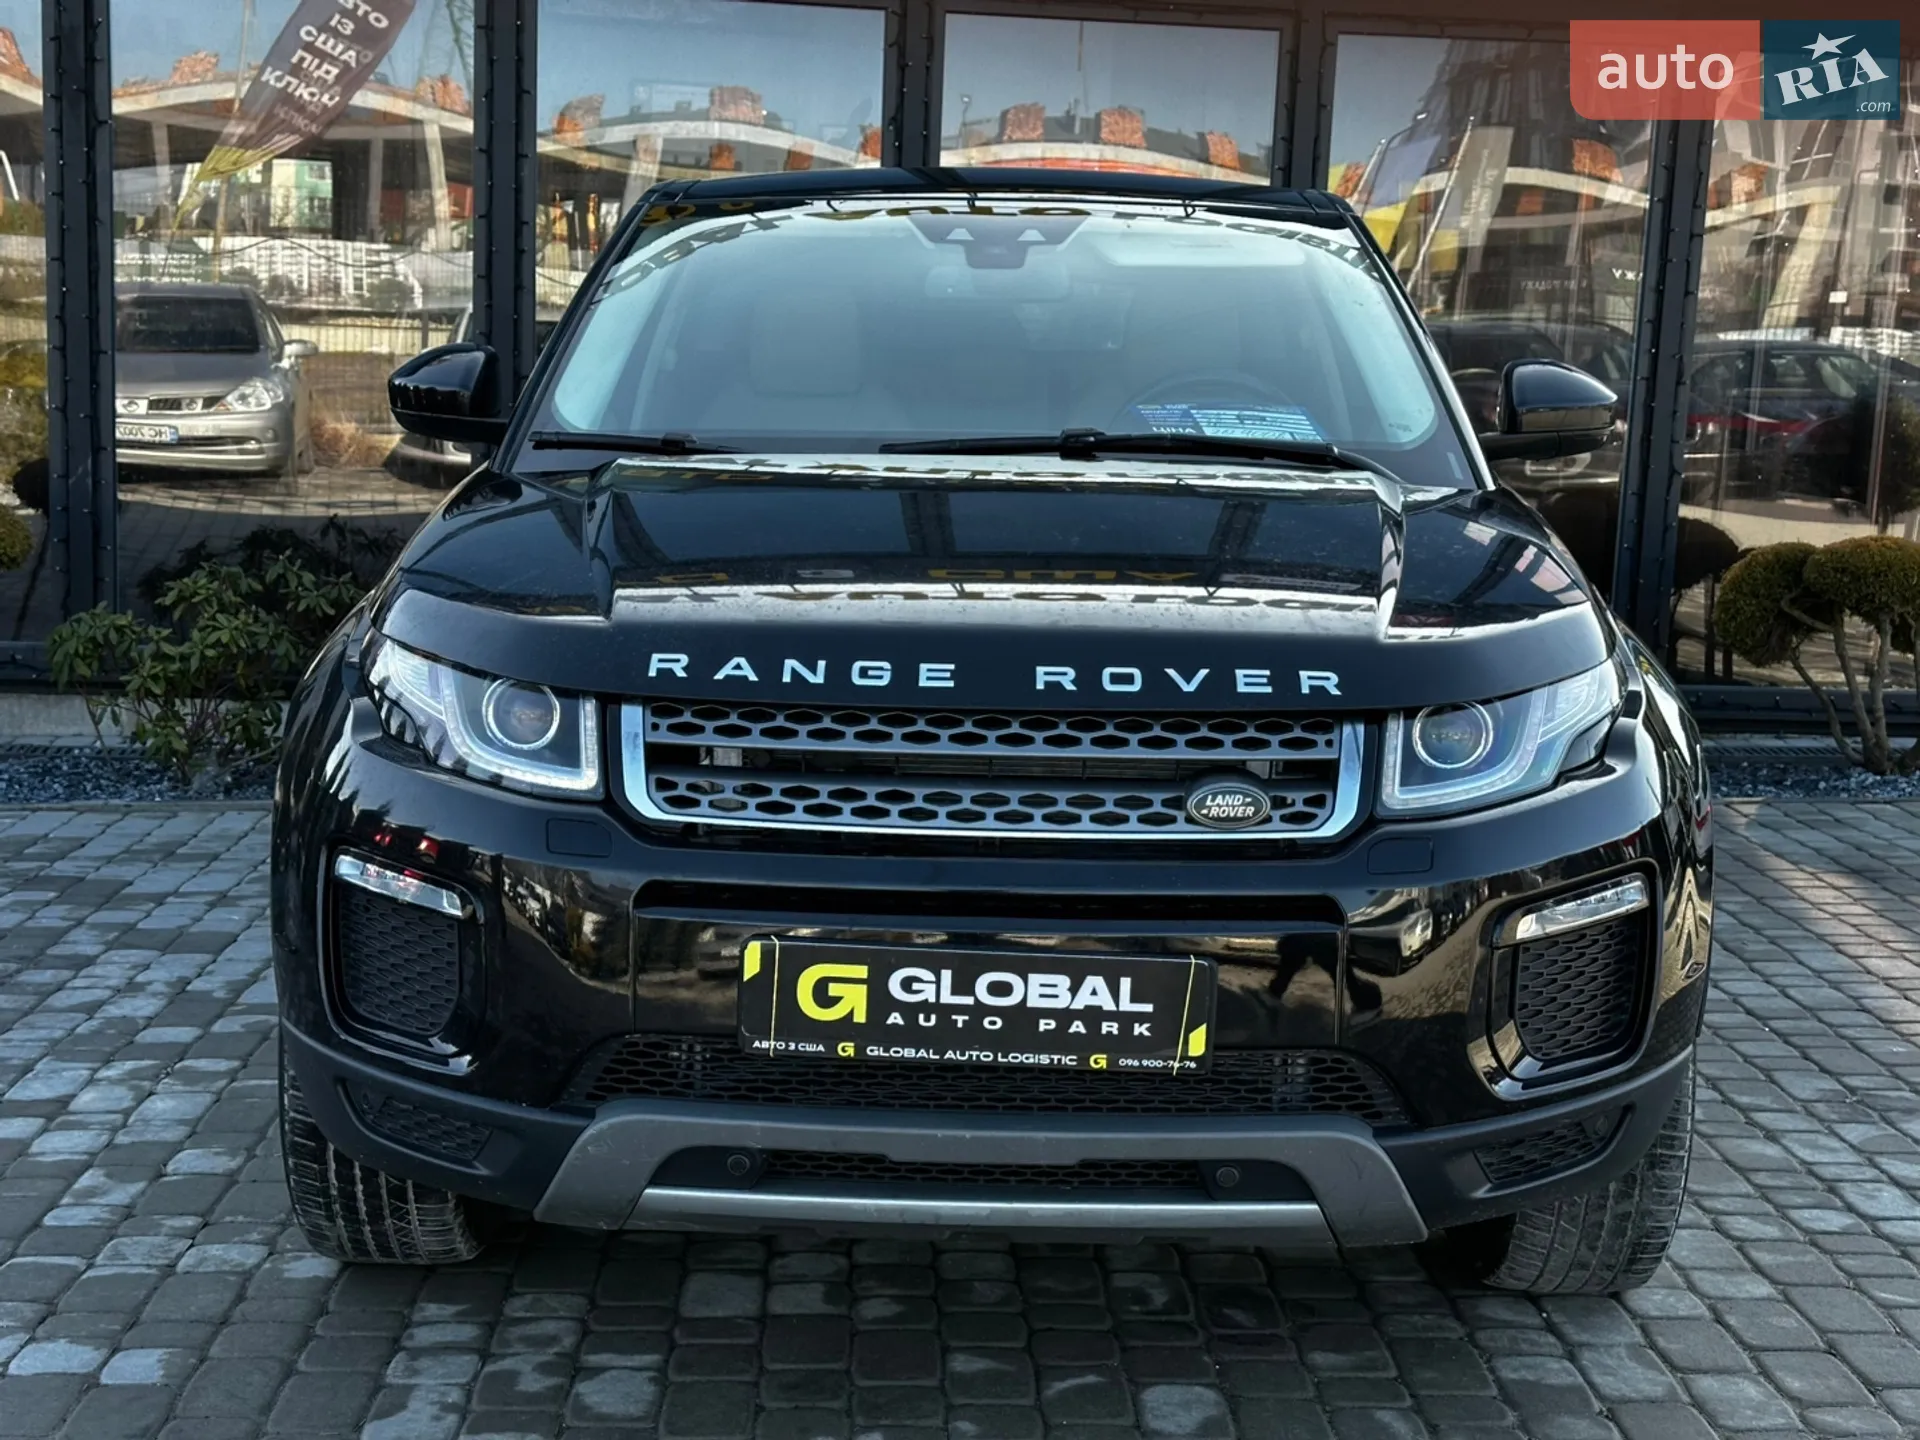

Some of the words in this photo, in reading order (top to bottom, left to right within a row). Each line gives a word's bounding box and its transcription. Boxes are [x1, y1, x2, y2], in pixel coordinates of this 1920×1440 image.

[299, 25, 357, 68] США
[290, 49, 340, 84] ПІД
[260, 66, 340, 108] КЛЮЧ
[648, 653, 955, 688] RANGE
[1036, 666, 1342, 695] ROVER
[1205, 794, 1243, 806] LAND
[1208, 806, 1255, 818] ROVER
[888, 967, 1154, 1013] GLOBAL
[886, 1012, 1003, 1030] AUTO
[1038, 1018, 1152, 1037] PARK
[752, 1040, 786, 1051] АВТО
[798, 1042, 826, 1052] США
[866, 1046, 940, 1060] GLOBAL
[944, 1050, 994, 1062] AUTO
[997, 1052, 1078, 1066] LOGISTIC
